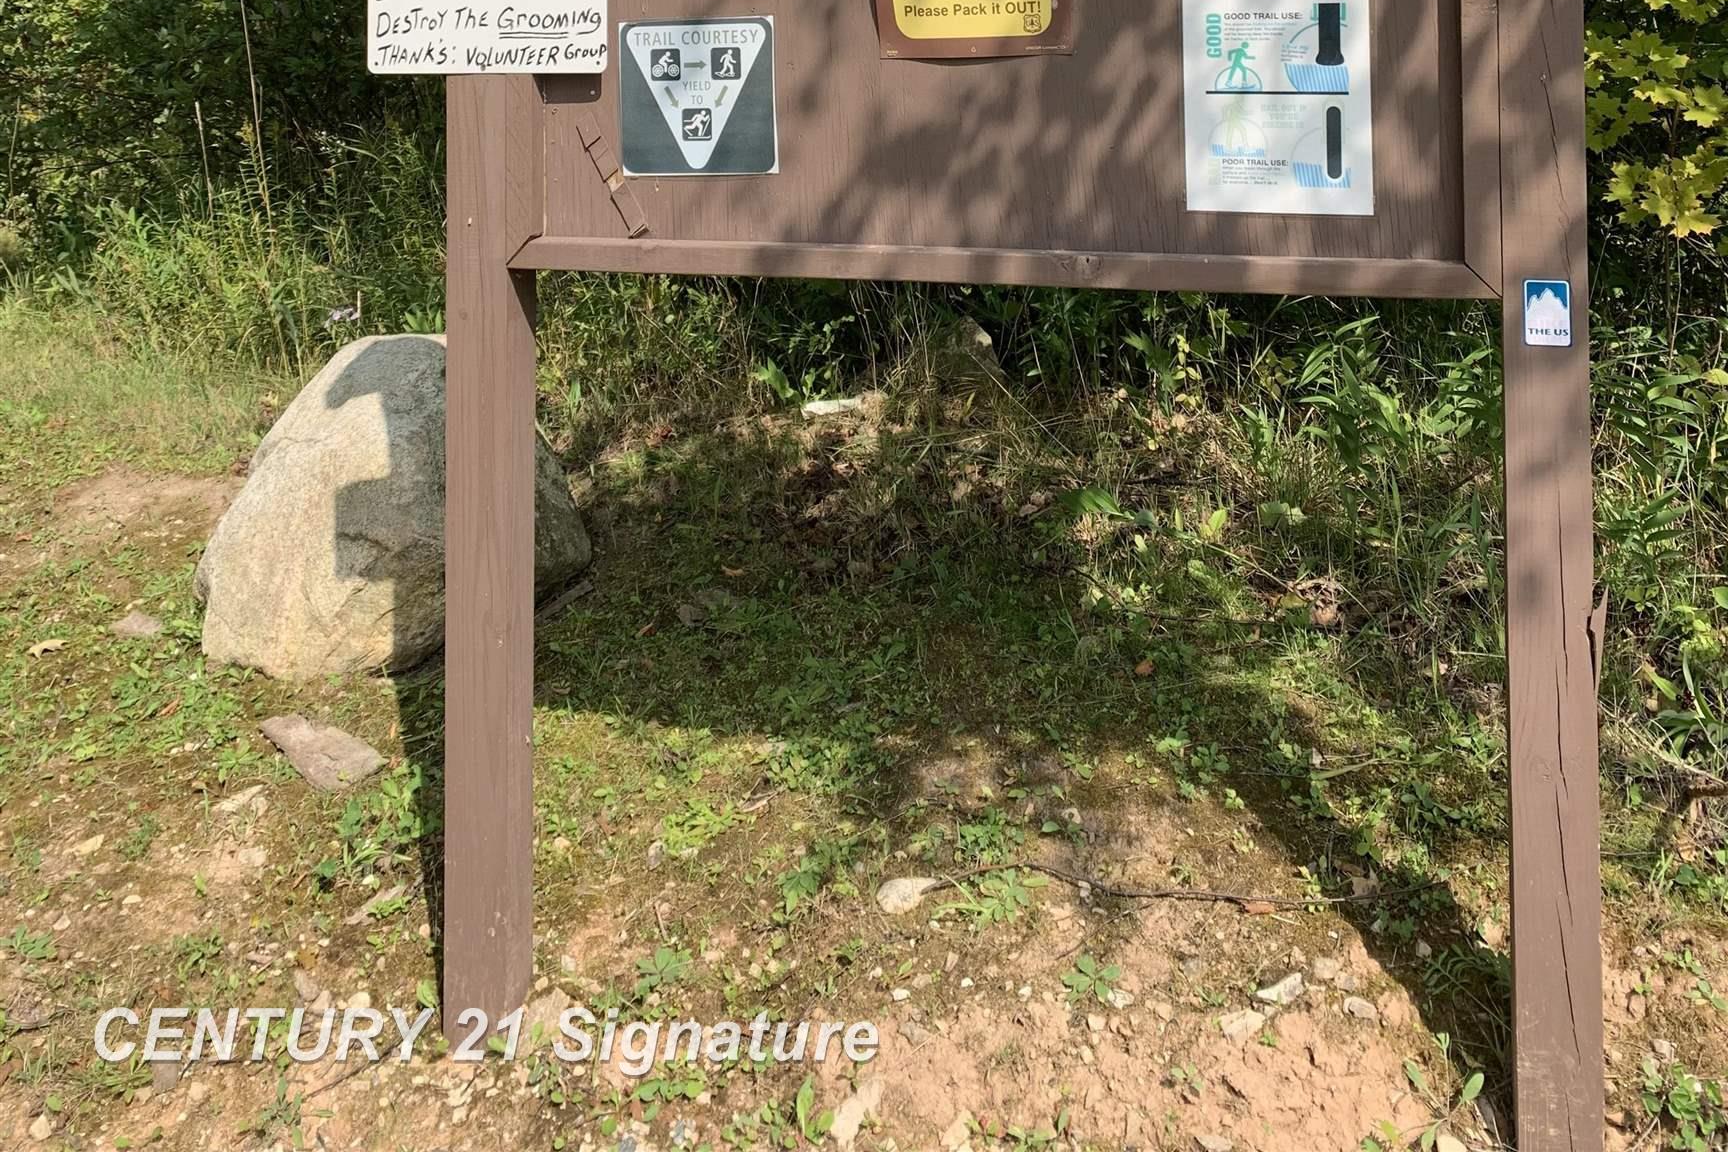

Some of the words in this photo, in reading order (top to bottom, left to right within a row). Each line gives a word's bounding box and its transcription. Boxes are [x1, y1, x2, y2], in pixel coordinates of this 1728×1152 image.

[904, 4, 949, 18] Please
[953, 2, 987, 16] Pack
[991, 2, 1001, 15] it
[1005, 0, 1042, 15] OUT!
[1223, 12, 1251, 20] GOOD
[1253, 12, 1279, 20] TRAIL
[634, 31, 675, 47] TRAIL
[681, 29, 759, 46] COURTESY
[1206, 13, 1222, 59] GOOD
[682, 80, 711, 91] YIELD
[690, 95, 703, 105] TO
[1554, 328, 1569, 336] US
